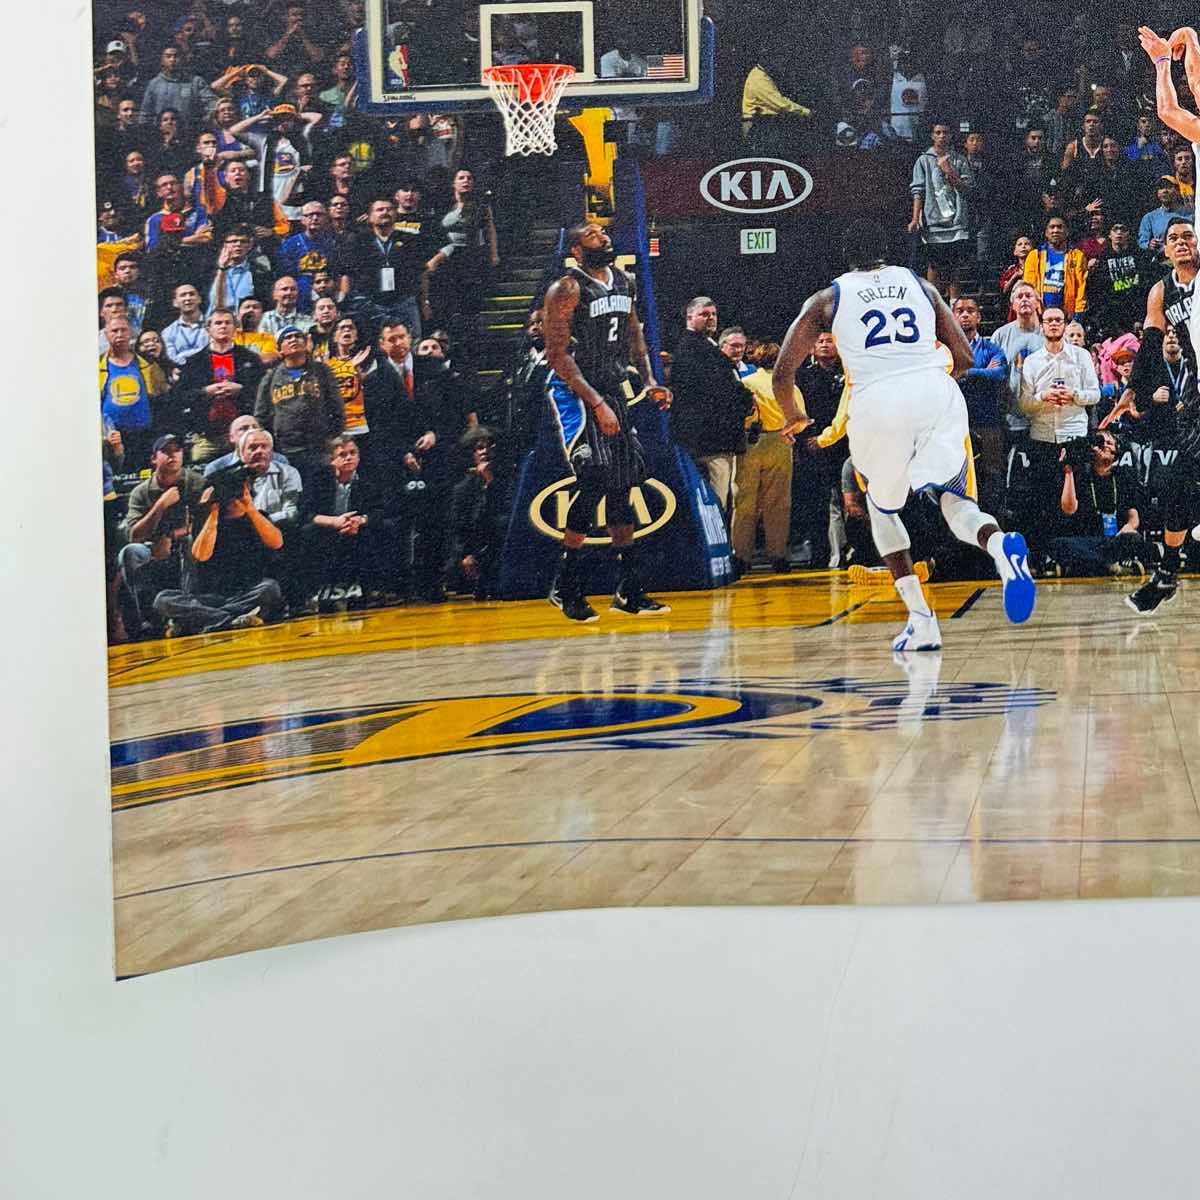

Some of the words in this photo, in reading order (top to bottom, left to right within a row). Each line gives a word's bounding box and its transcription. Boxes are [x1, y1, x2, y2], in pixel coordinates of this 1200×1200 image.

[719, 170, 795, 201] KIA
[746, 231, 772, 250] EXIT
[857, 285, 908, 304] GREEN
[607, 317, 619, 342] 2
[860, 307, 920, 350] 23
